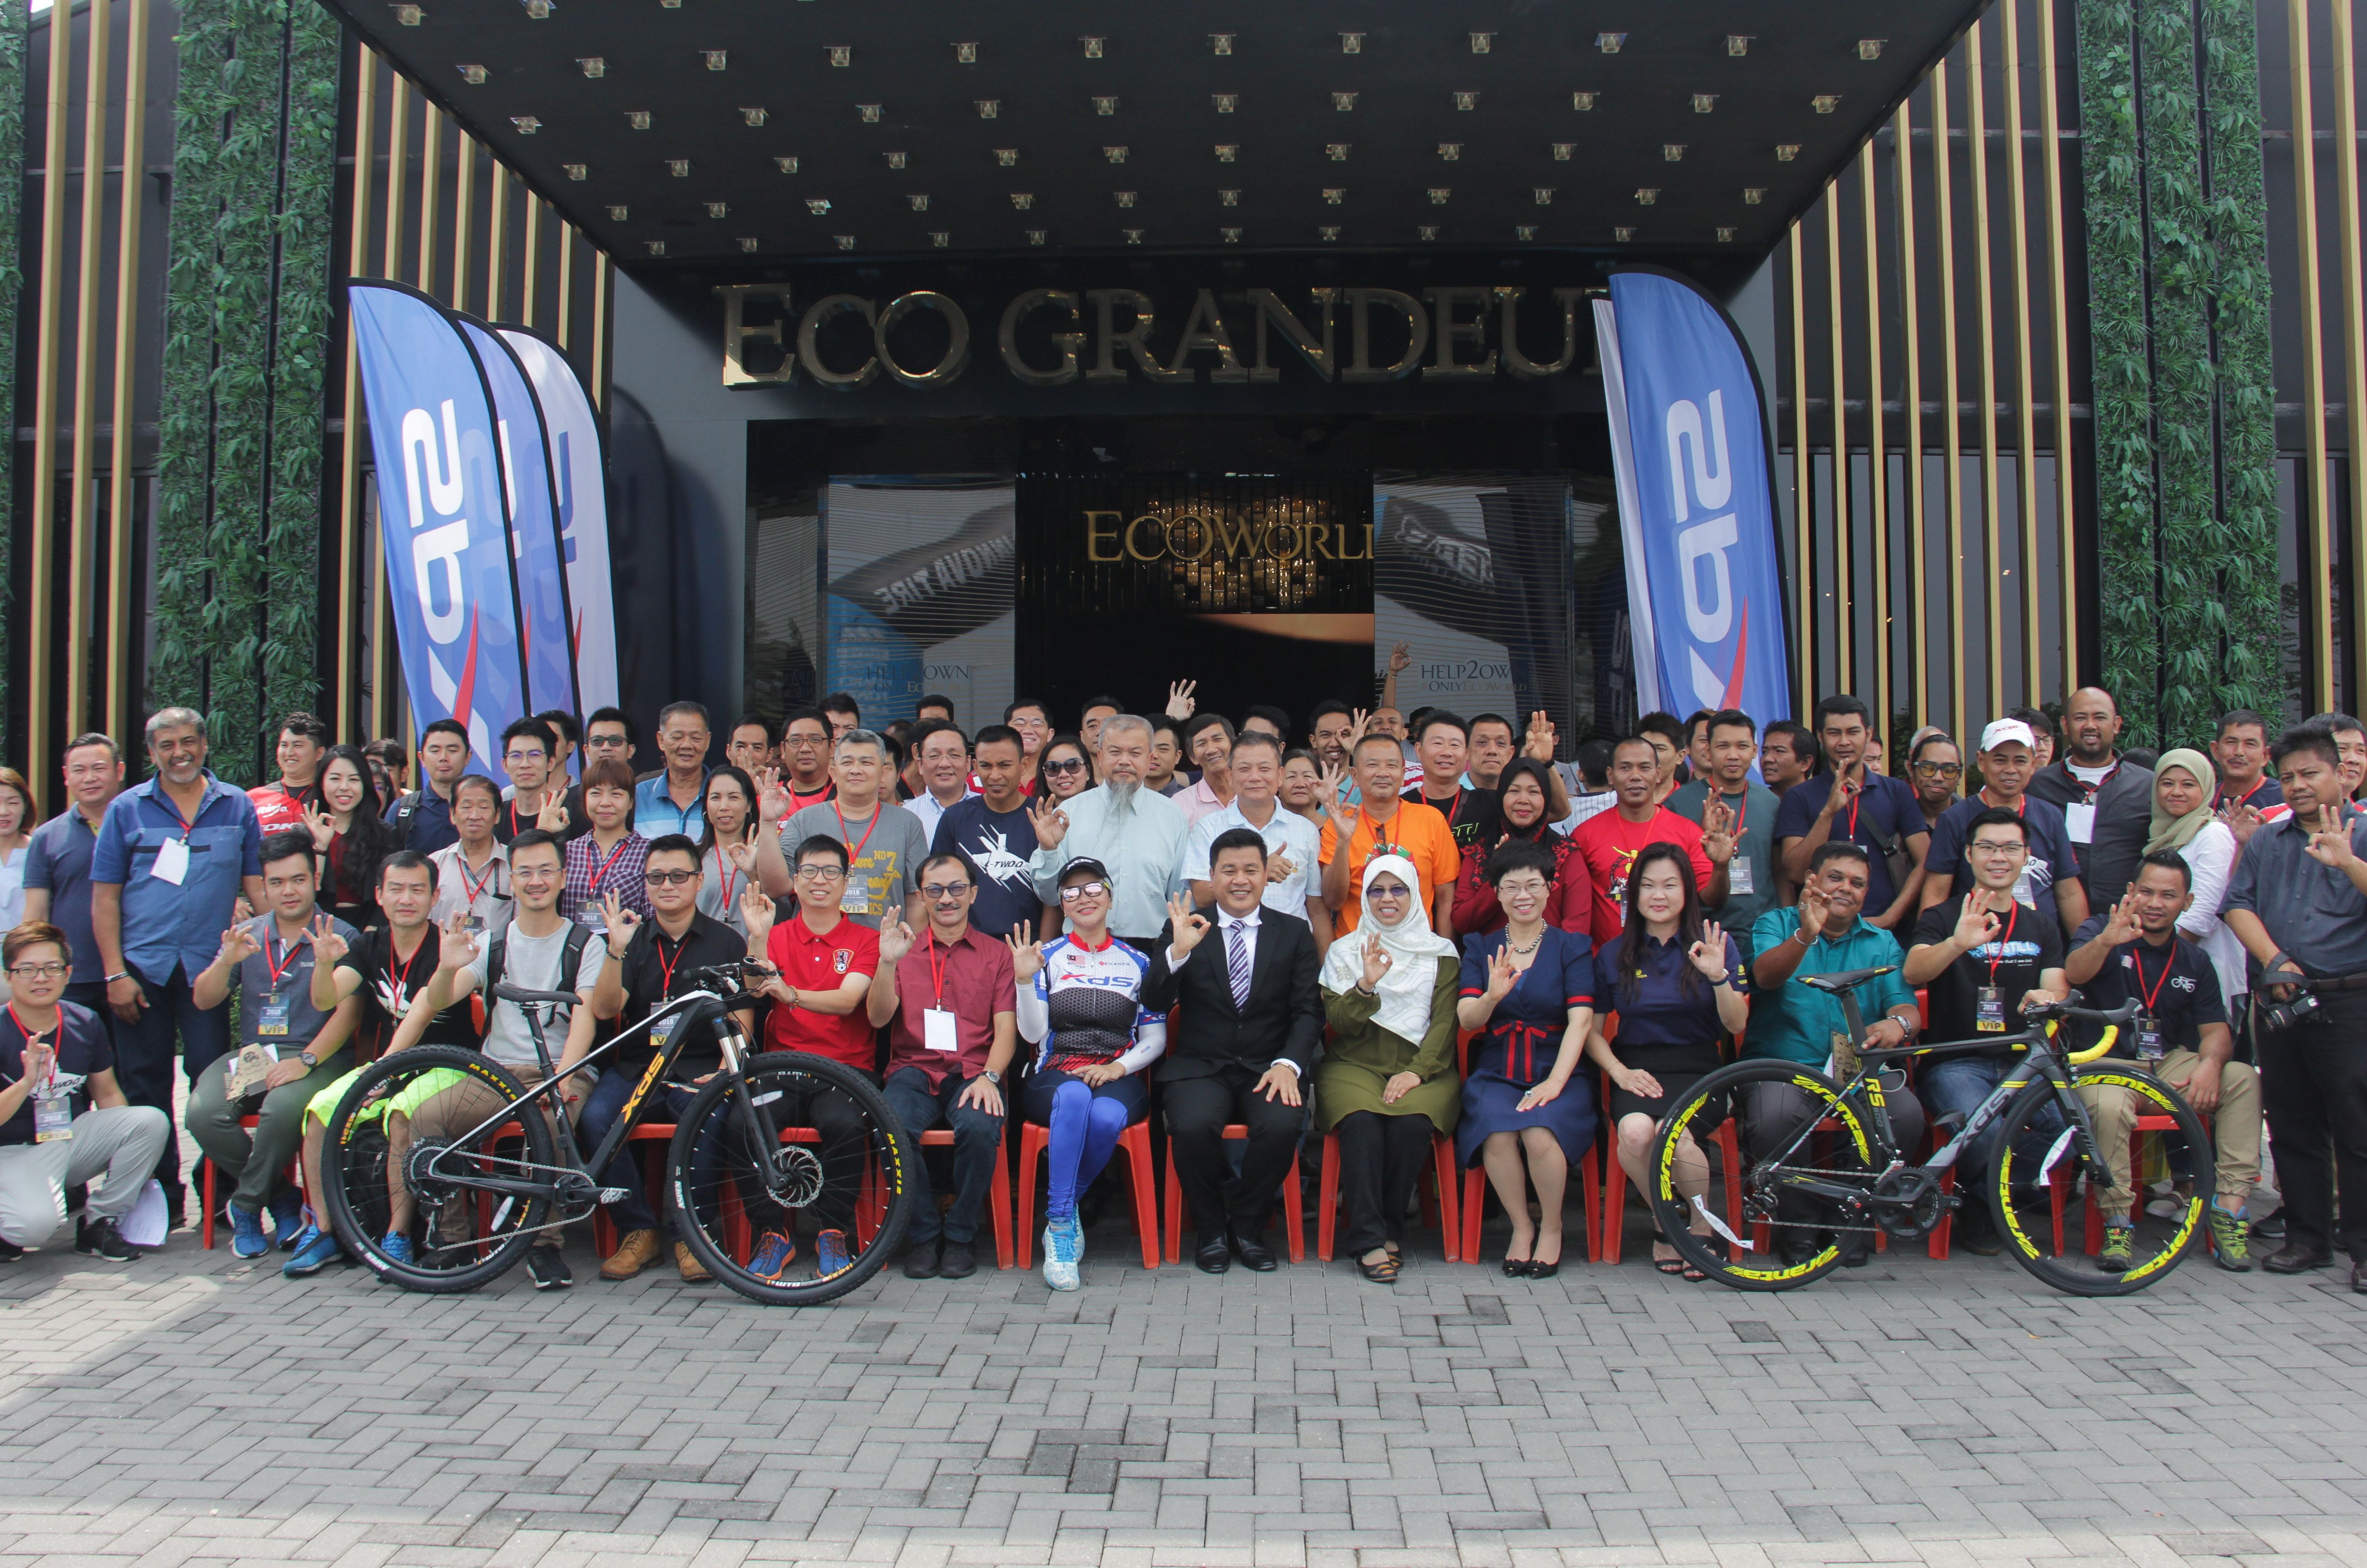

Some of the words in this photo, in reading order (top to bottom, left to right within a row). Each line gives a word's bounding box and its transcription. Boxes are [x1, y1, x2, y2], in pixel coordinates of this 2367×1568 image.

[997, 287, 1606, 385] GRANDEU
[2003, 941, 2034, 954] STILL
[1982, 1022, 2001, 1030] VIP
[469, 1063, 517, 1100] MAXXIS
[1864, 1078, 1887, 1107] RS
[886, 1133, 902, 1195] MAXXIS
